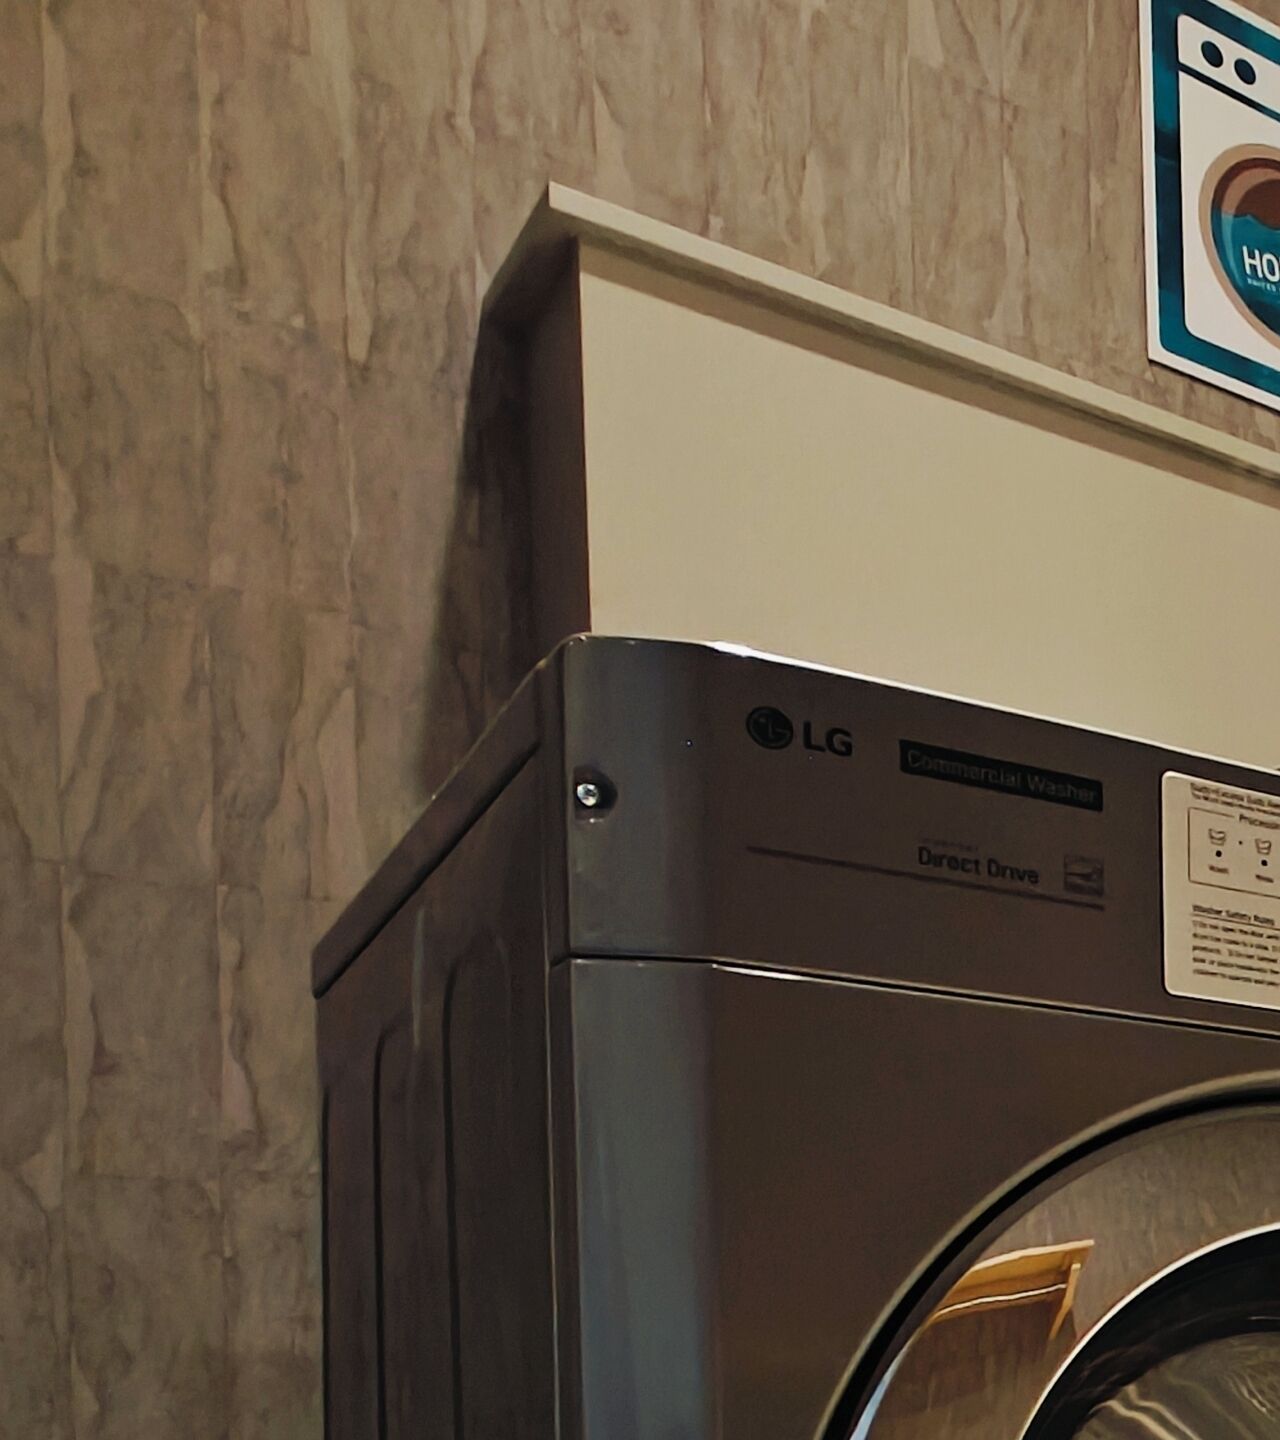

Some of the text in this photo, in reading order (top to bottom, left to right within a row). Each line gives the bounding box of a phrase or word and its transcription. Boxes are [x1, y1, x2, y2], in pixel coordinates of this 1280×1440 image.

[803, 721, 853, 757] LG
[907, 749, 1096, 804] Commercial Washer
[918, 846, 1040, 885] Direct Drive
